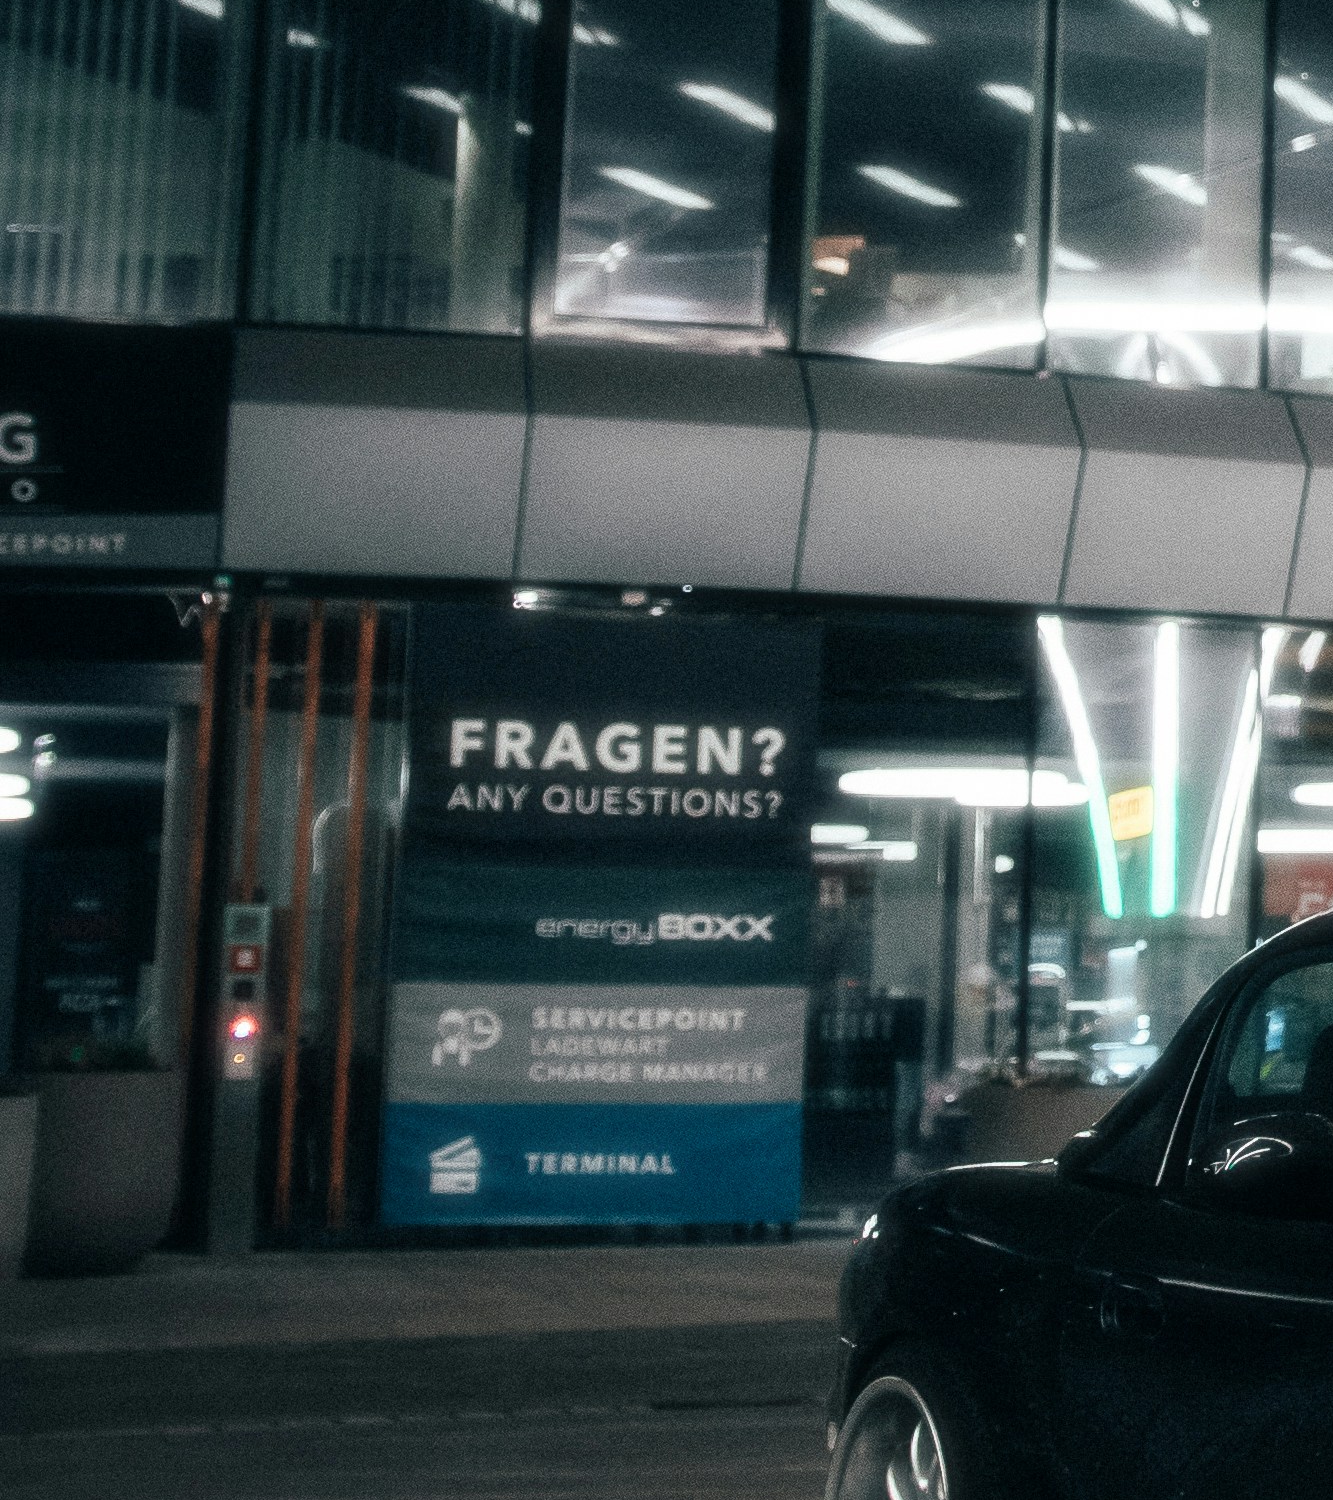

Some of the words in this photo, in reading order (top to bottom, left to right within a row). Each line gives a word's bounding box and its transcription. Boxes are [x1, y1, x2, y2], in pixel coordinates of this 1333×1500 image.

[448, 717, 787, 778] FRAGEN?
[446, 783, 531, 813] ANY
[541, 783, 784, 819] QUESTIONS?
[534, 912, 775, 945] energyBOXX
[531, 1006, 747, 1032] SERVICEPOINT
[529, 1035, 670, 1058] LADEWART
[527, 1061, 634, 1084] CHARGE
[641, 1061, 769, 1084] MANAGER
[524, 1152, 677, 1176] TERMINAL
